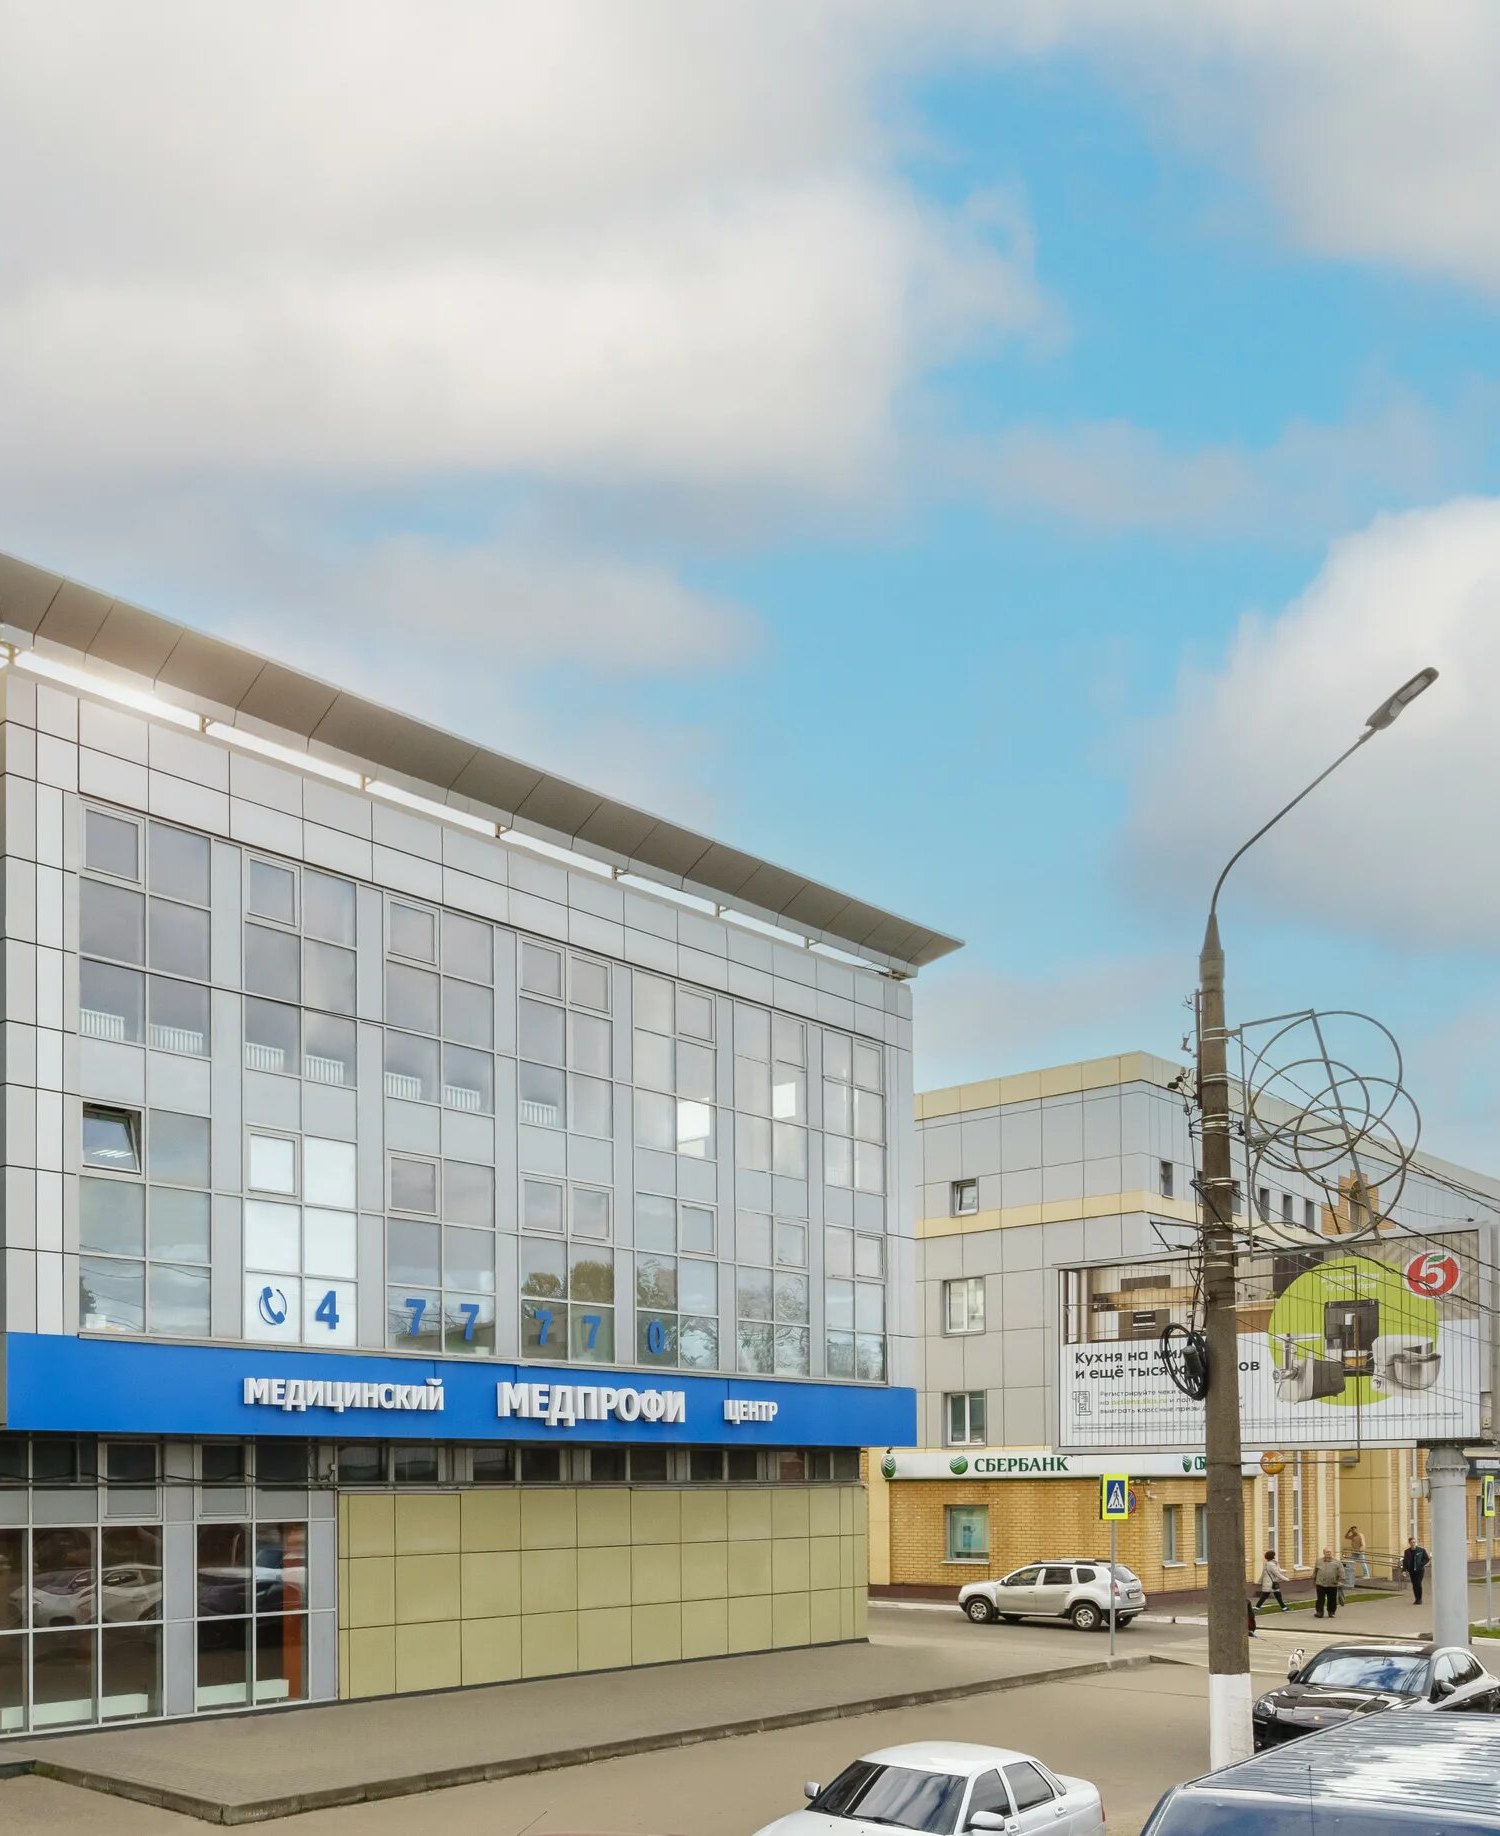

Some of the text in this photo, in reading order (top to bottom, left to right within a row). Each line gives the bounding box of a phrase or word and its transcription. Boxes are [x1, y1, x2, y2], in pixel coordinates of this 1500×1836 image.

[1075, 1351, 1123, 1366] Кухня
[1128, 1350, 1148, 1362] на
[1075, 1368, 1085, 1380] и
[1090, 1365, 1124, 1381] ещё
[243, 1377, 779, 1427] МЕДИЦИНСКИЙ МЕДПРОФИ ЦЕНТР
[974, 1456, 1069, 1473] СБЕРБАНК
